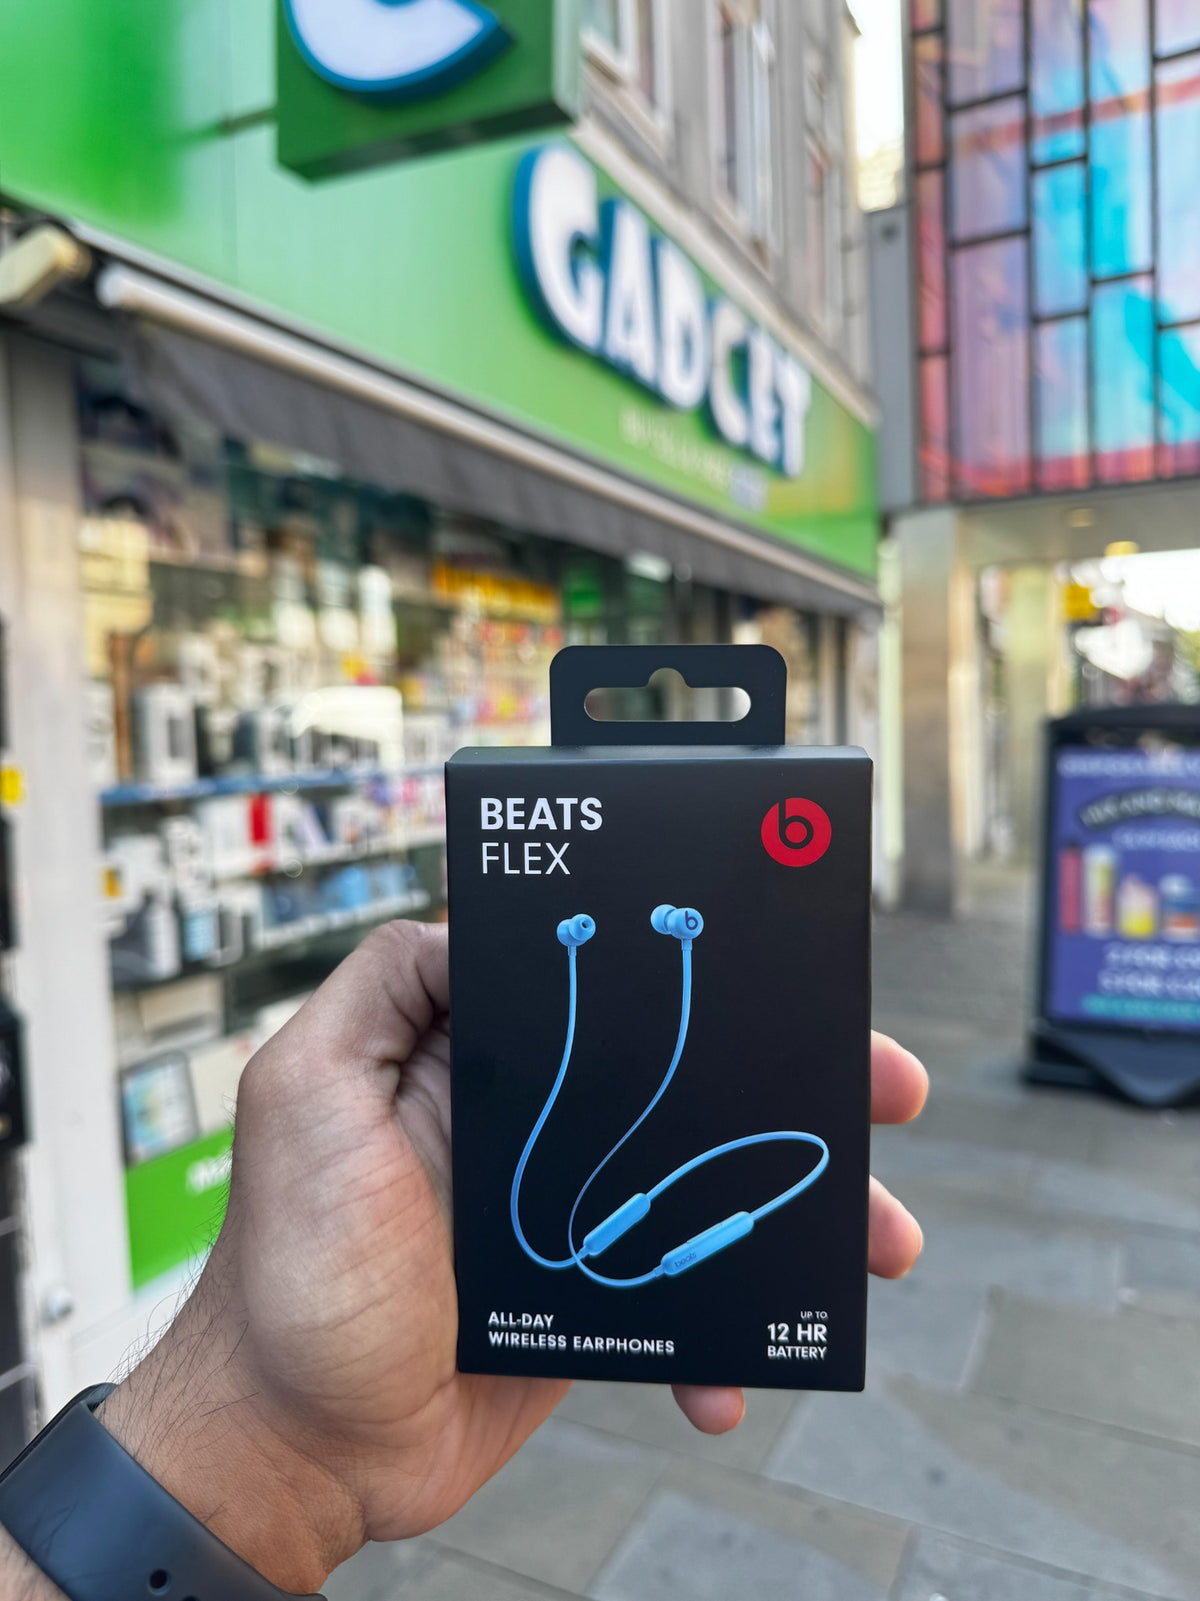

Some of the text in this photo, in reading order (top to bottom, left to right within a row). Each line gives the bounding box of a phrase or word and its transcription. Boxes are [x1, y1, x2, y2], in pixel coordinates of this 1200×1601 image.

[481, 796, 603, 831] BEATS
[481, 842, 571, 876] FLEX
[488, 1311, 554, 1328] ALL-DAY
[800, 1311, 828, 1321] UP TO
[767, 1322, 828, 1343] 12 HR
[488, 1331, 675, 1356] WIRELESS EARPHONES
[767, 1345, 828, 1360] BATTERY
